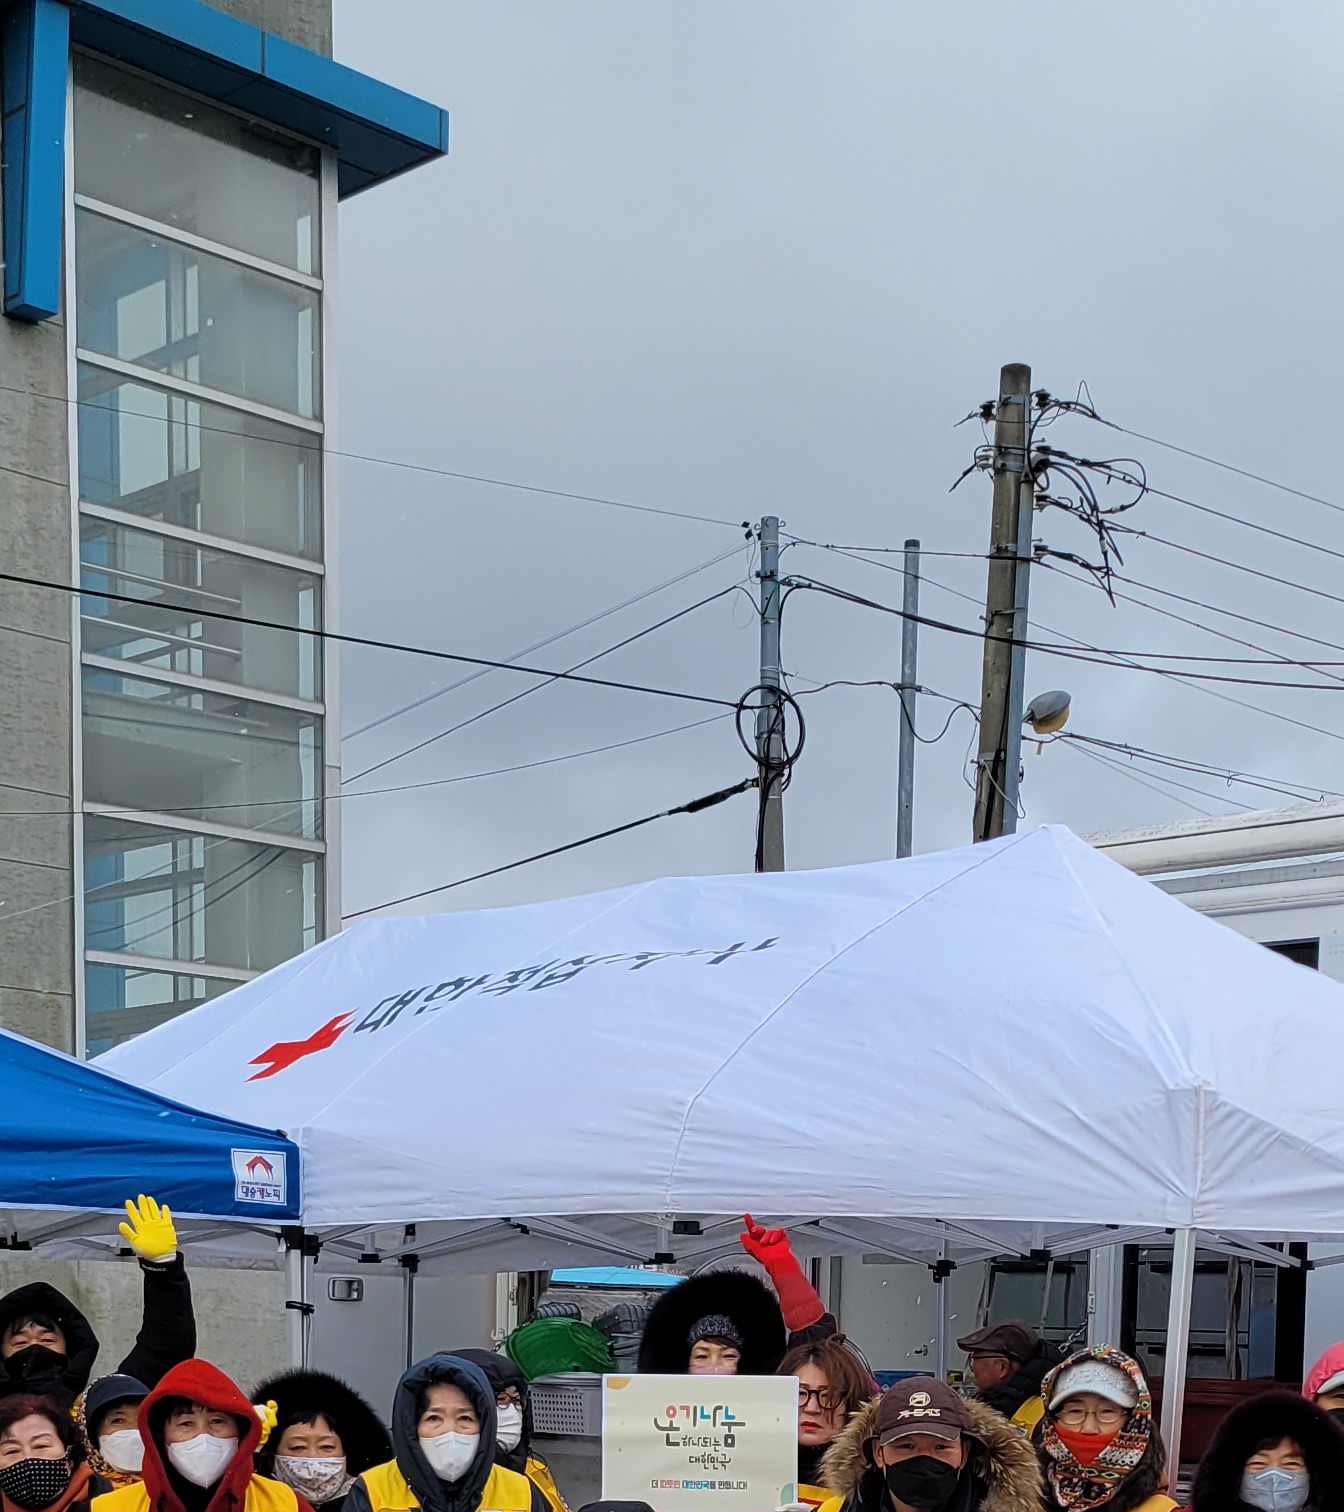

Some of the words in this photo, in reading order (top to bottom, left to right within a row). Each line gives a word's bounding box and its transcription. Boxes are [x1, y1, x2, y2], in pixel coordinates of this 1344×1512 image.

[654, 1405, 747, 1448] 온기나눔
[681, 1435, 722, 1452] 하나되는
[688, 1452, 732, 1470] 대한민국
